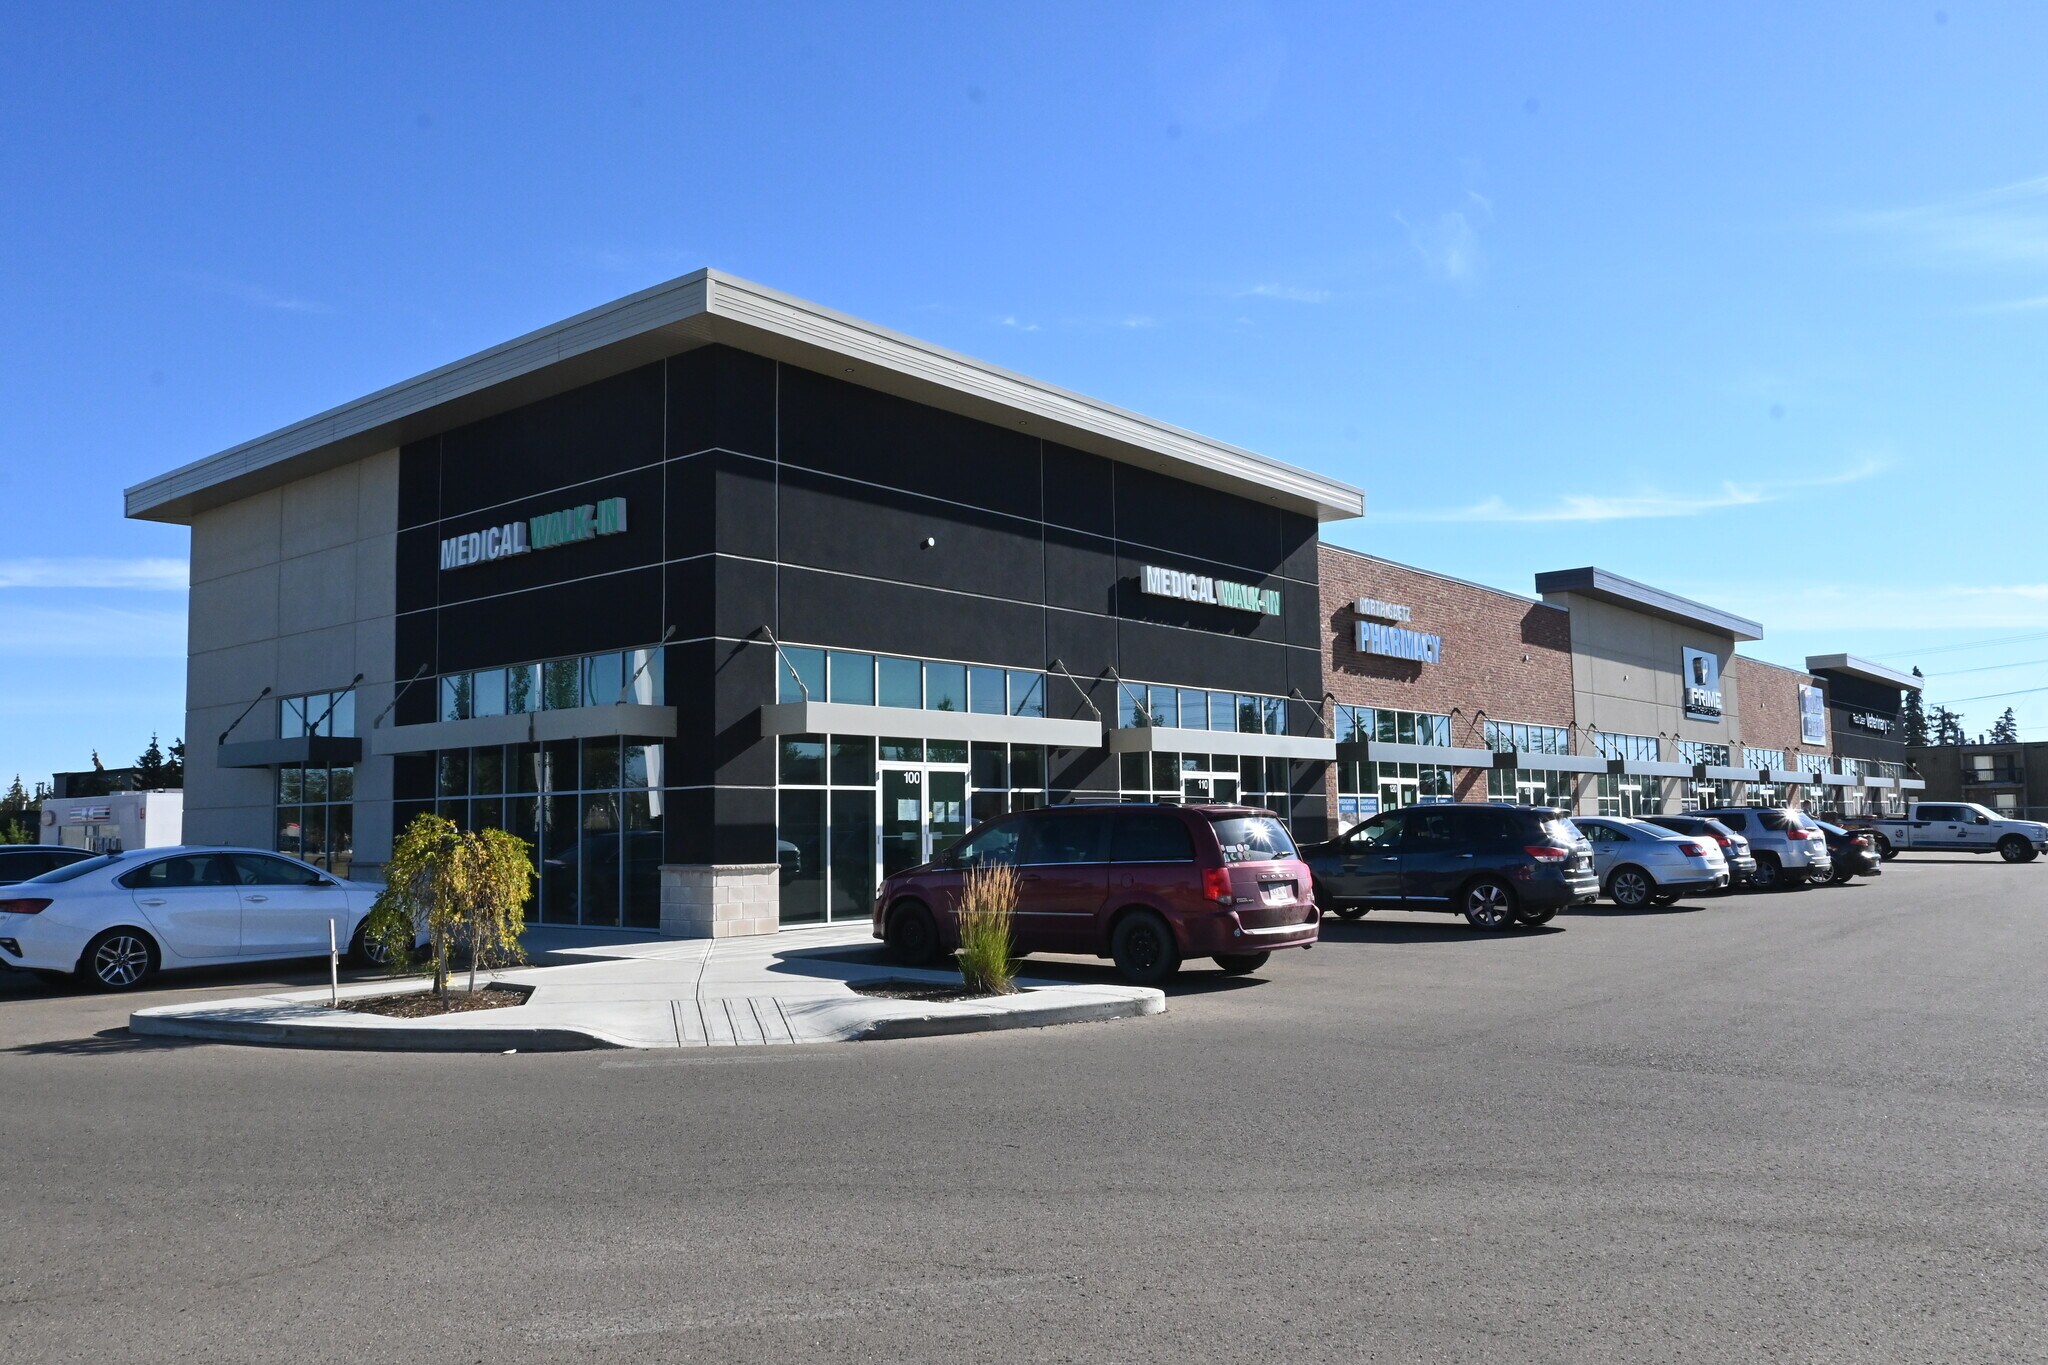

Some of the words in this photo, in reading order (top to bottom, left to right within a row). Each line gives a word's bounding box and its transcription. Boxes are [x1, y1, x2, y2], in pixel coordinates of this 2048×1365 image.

[440, 521, 531, 570] MEDICAL
[530, 496, 627, 550] WALK-IN
[1142, 565, 1217, 604] MEDICAL
[1216, 579, 1281, 616] WALK-IN
[1356, 596, 1385, 618] NORTH
[1356, 620, 1441, 664] PHARMACY
[1690, 687, 1722, 709] PRIME
[903, 771, 920, 784] 100
[1197, 779, 1208, 790] 110
